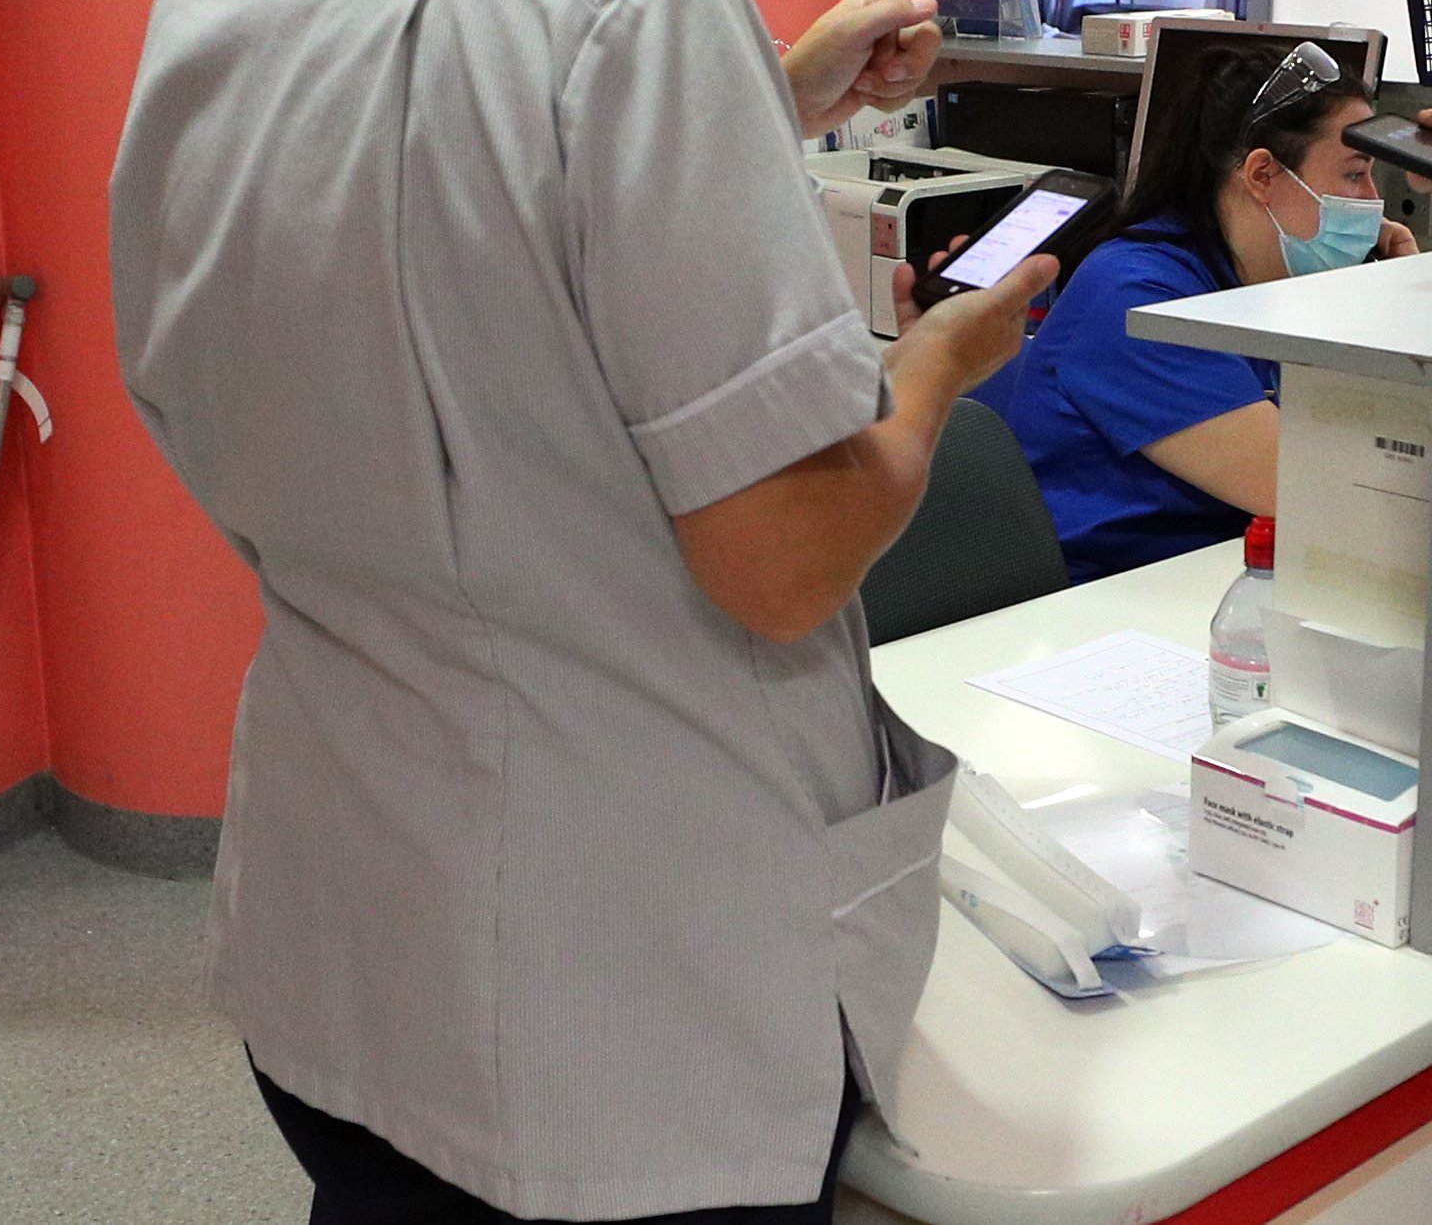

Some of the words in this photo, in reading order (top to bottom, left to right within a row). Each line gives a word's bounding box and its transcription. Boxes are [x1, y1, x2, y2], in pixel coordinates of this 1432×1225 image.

[1204, 795, 1218, 809] Face
[1219, 804, 1236, 815] mask
[1237, 811, 1252, 821] with
[1253, 816, 1275, 830] elastic
[1276, 825, 1294, 839] strap
